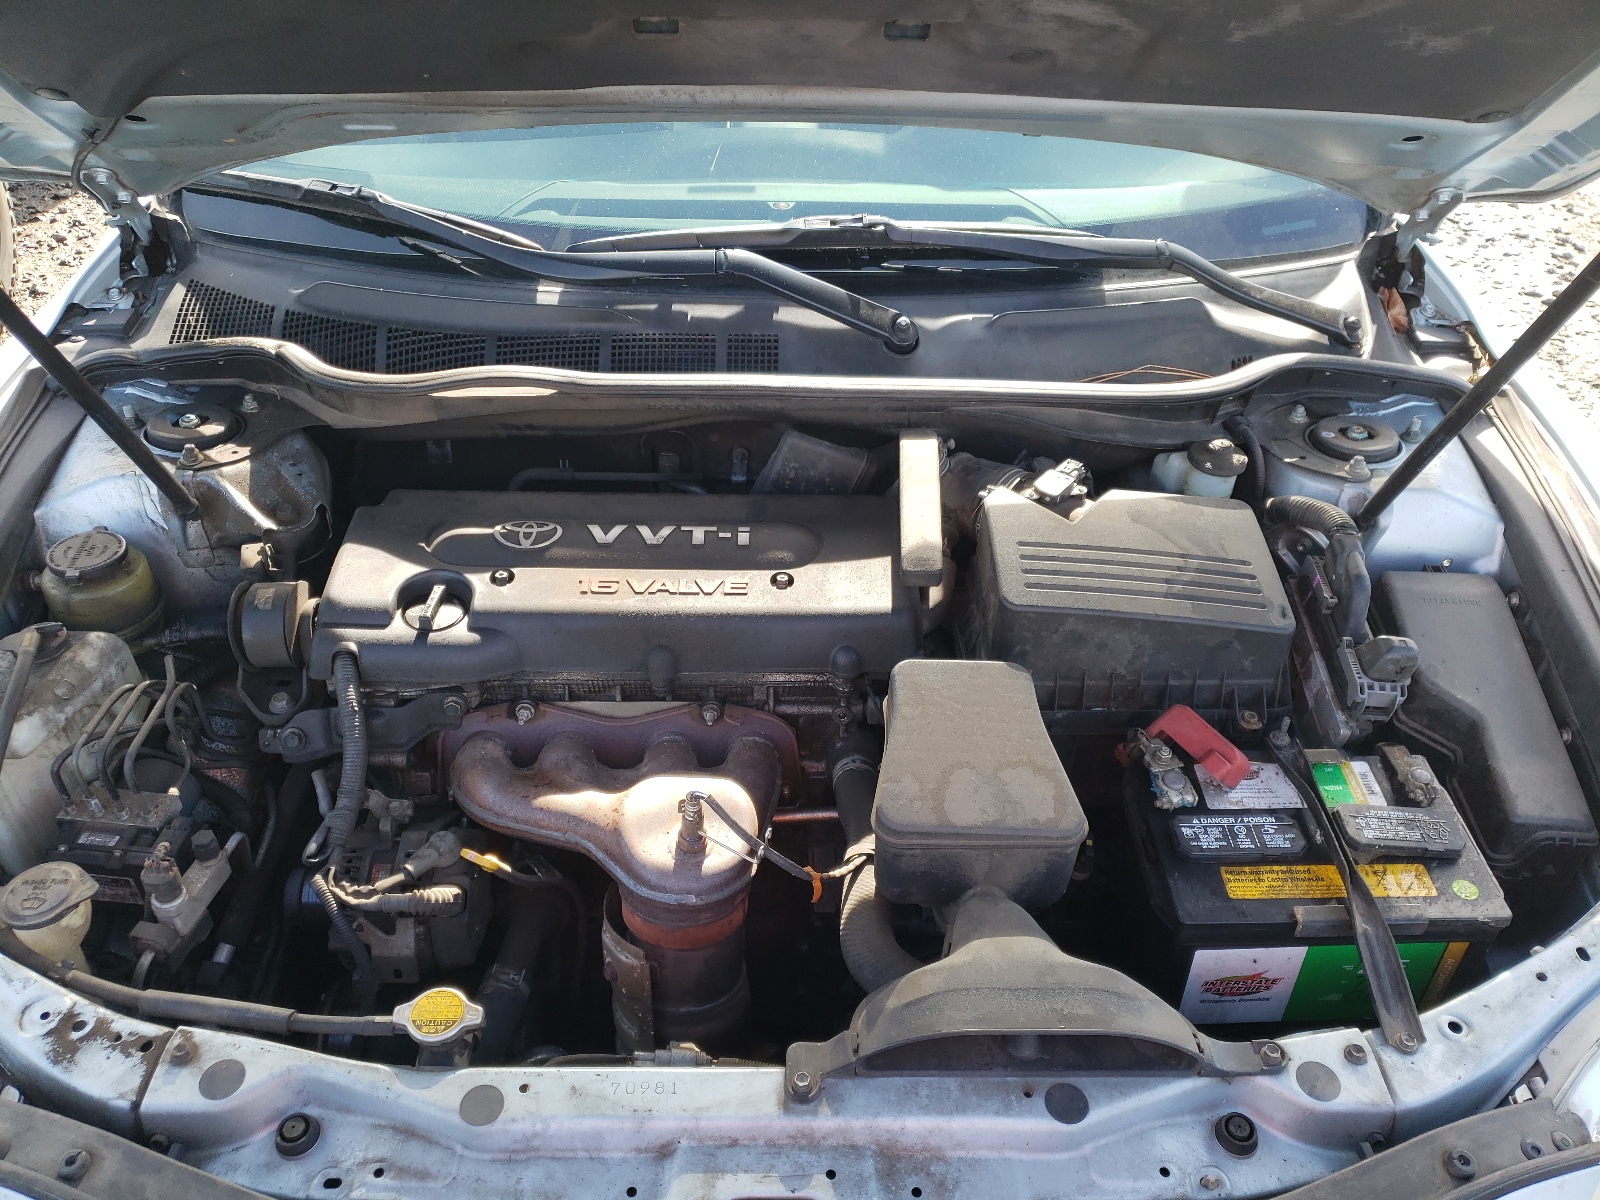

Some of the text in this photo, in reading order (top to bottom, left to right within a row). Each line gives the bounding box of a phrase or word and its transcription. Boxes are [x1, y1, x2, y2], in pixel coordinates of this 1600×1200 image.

[586, 524, 751, 546] VVT-i
[578, 577, 749, 596] 16 VALVE
[1202, 979, 1280, 988] INTERSTATE
[1202, 985, 1274, 994] BATTERIES
[611, 1081, 678, 1095] 70981
